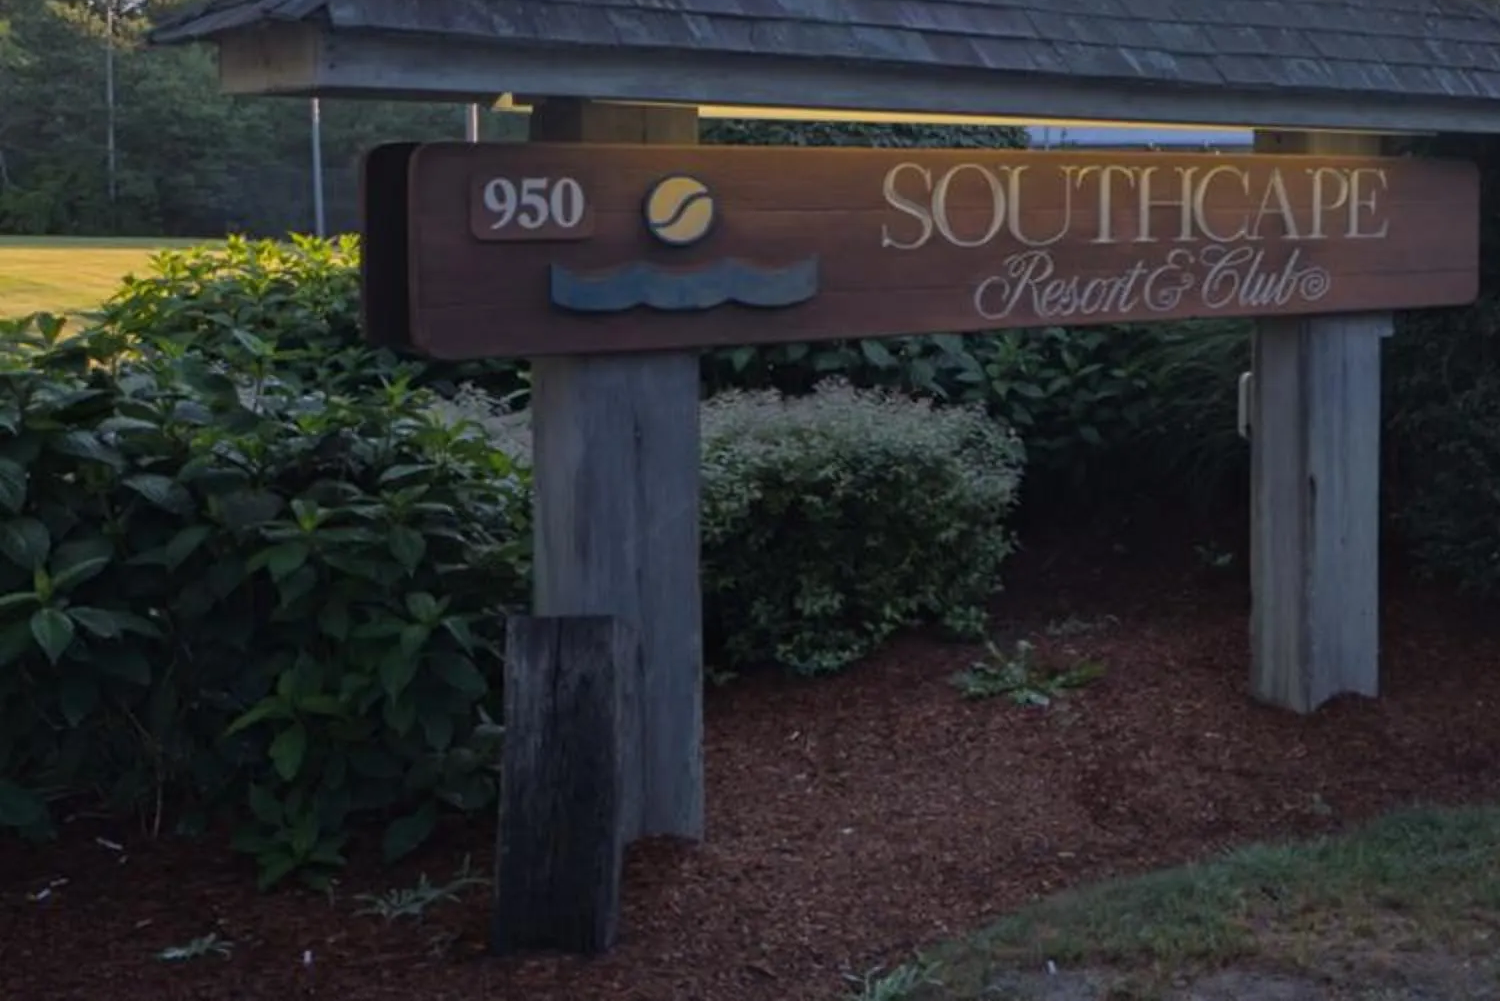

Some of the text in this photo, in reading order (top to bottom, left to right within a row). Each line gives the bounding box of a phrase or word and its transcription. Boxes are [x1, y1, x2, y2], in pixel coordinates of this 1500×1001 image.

[484, 176, 585, 230] 950
[880, 162, 1389, 249] SOUTHCAPE
[975, 246, 1330, 320] Resort & Club
